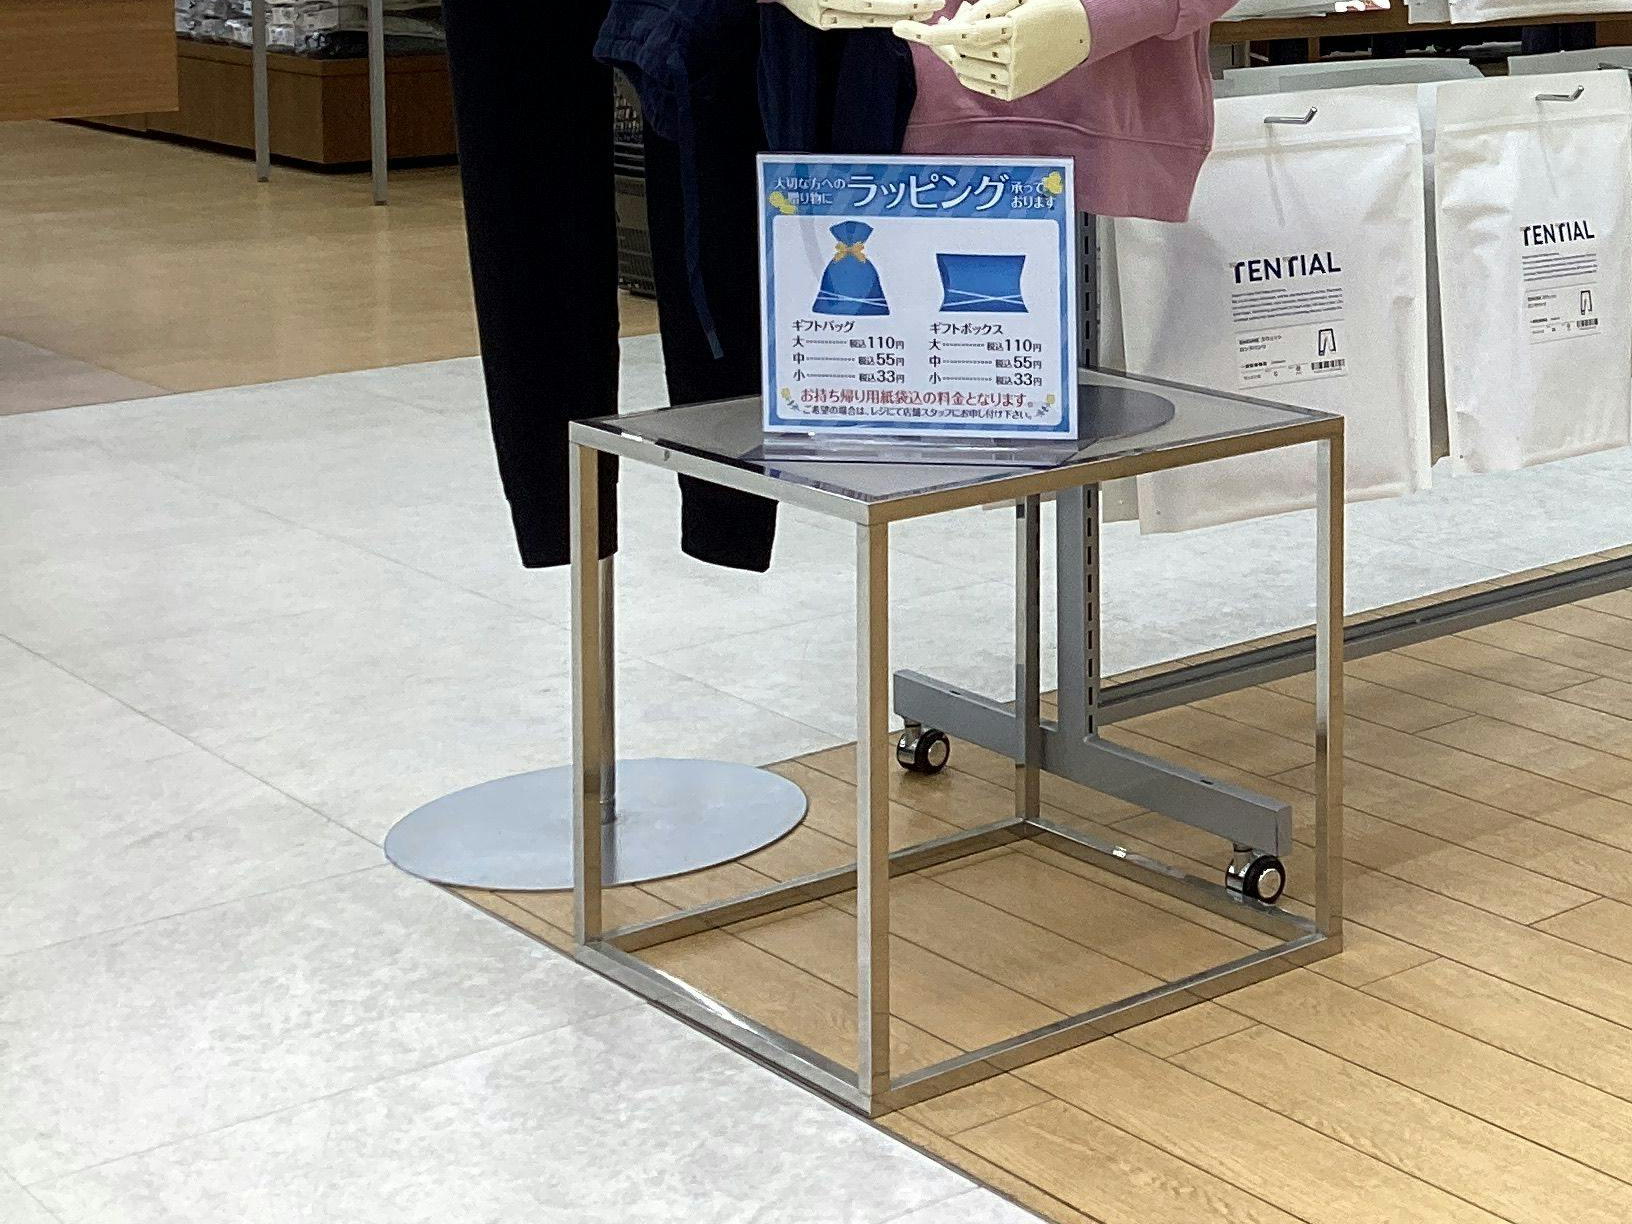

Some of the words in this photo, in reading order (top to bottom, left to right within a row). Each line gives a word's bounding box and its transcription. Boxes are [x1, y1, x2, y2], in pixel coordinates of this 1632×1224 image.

[847, 173, 1009, 211] ラッピング
[1011, 195, 1056, 210] おります
[1521, 220, 1595, 246] TENTIAL
[1231, 252, 1342, 284] TENTIAL
[792, 319, 856, 333] ギフトバッグ
[929, 322, 1003, 336] ギフトボックス
[793, 335, 804, 348] 大
[928, 338, 941, 351] 大
[793, 352, 805, 364] 中
[928, 355, 941, 367] 中
[793, 369, 805, 381] 小
[928, 372, 941, 384] 小
